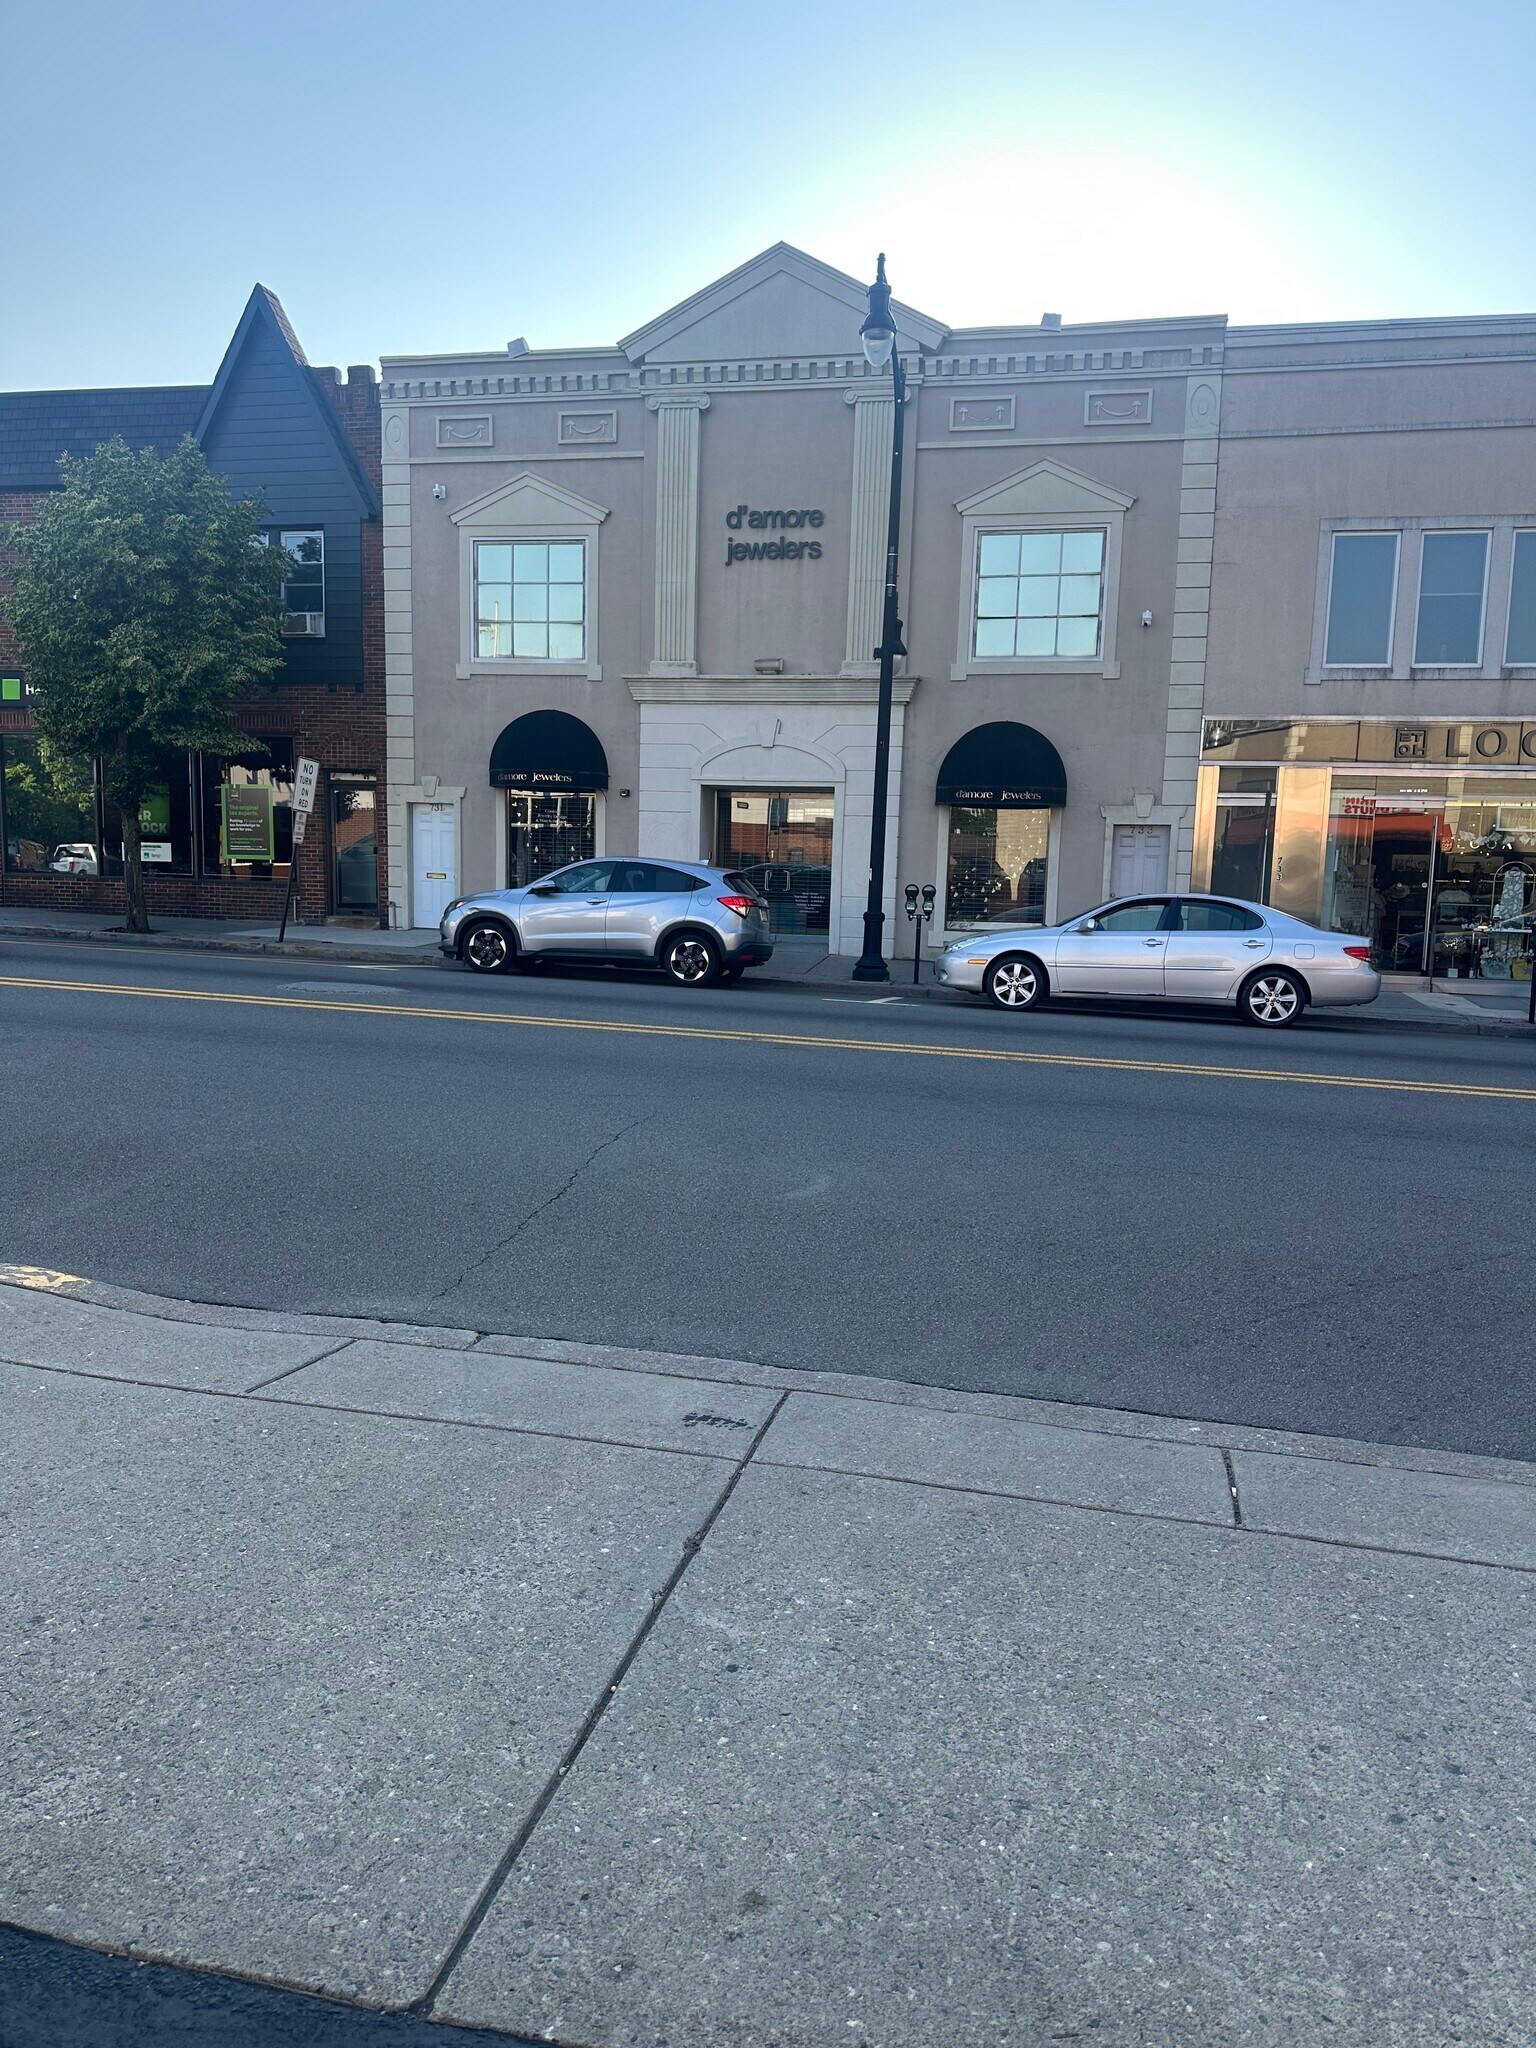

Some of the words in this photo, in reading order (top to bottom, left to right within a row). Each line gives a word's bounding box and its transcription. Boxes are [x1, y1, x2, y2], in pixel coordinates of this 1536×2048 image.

[726, 505, 824, 529] d'amore
[725, 536, 822, 566] jewelers
[303, 763, 314, 775] NO
[299, 775, 312, 786] TURN
[532, 772, 573, 783] jewelers
[300, 788, 310, 797] ON
[1001, 790, 1042, 801] jewelers
[298, 798, 309, 808] RED
[141, 822, 168, 833] OCK
